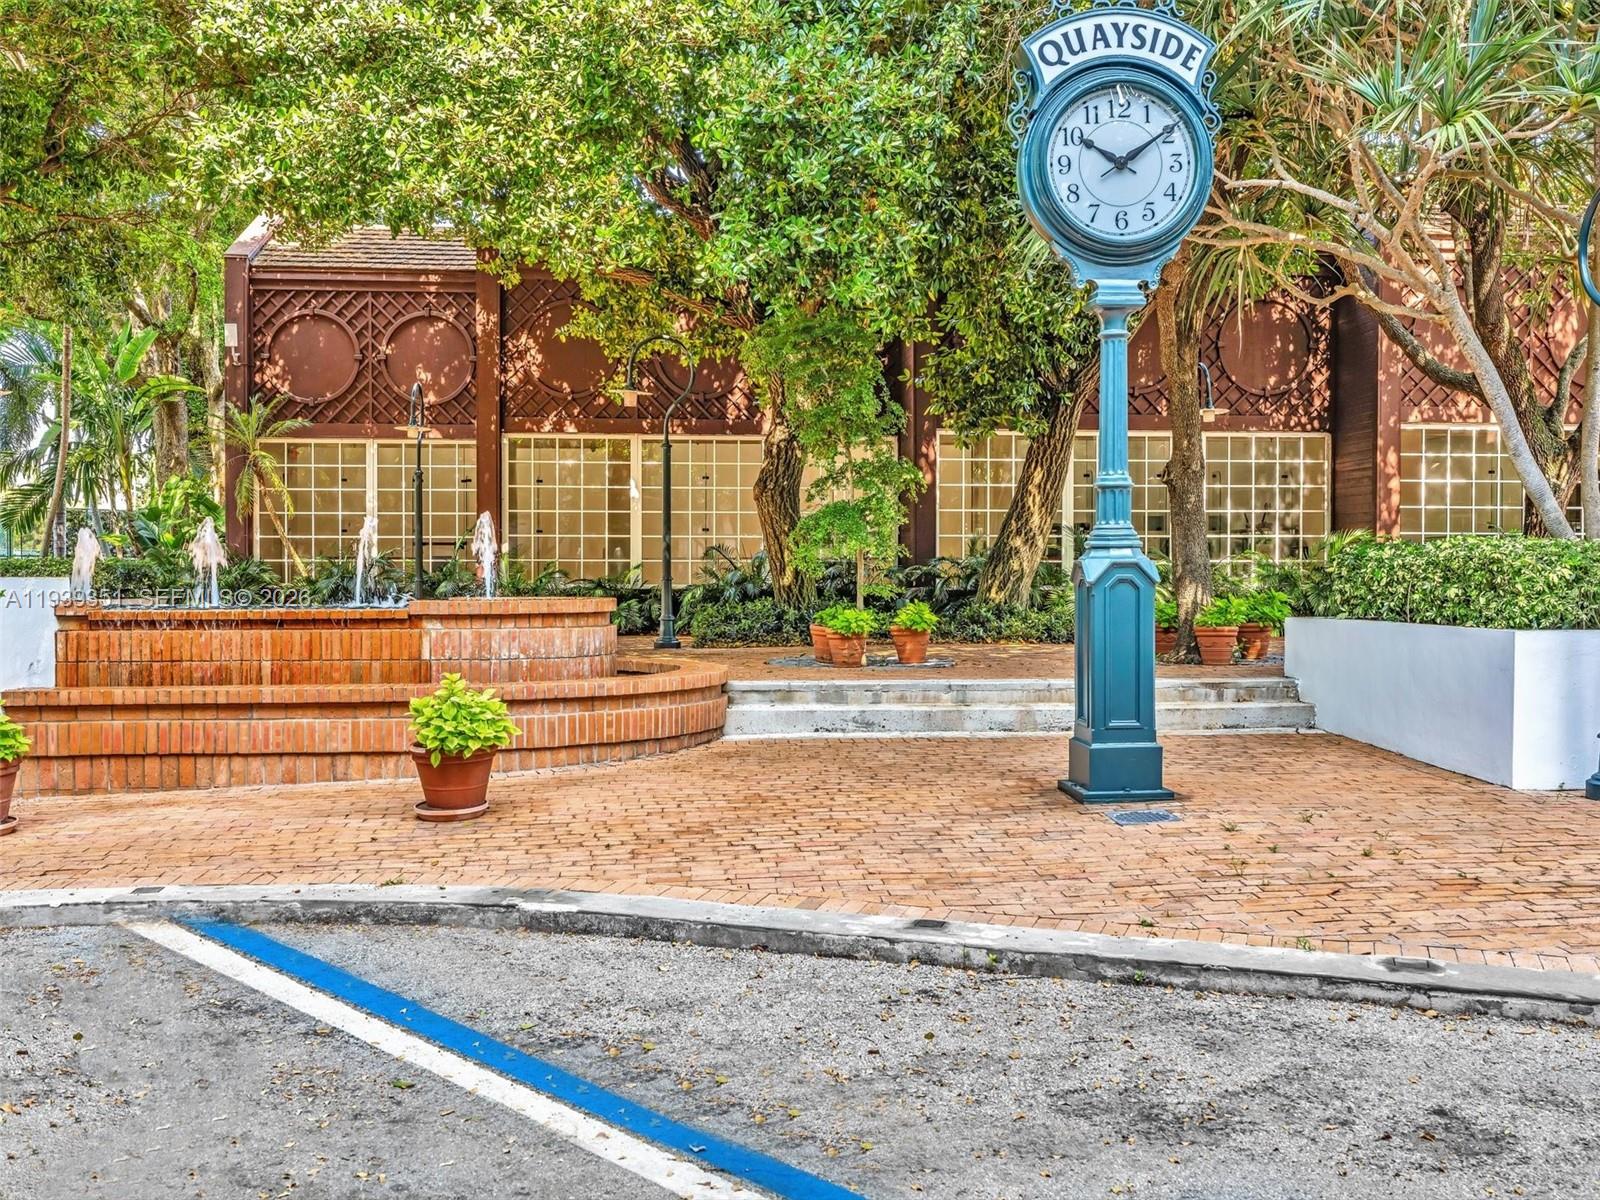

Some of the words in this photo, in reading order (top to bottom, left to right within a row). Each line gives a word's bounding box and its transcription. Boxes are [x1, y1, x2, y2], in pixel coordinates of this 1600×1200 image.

[1037, 22, 1202, 71] QUAYSIDE
[1084, 105, 1099, 124] 11
[1108, 100, 1131, 118] 12
[1144, 105, 1150, 123] 1
[1062, 127, 1083, 146] 10
[1057, 154, 1071, 175] 9
[1169, 153, 1183, 172] 3
[1066, 183, 1080, 203] 8
[1163, 182, 1177, 201] 4
[1088, 204, 1100, 223] 7
[1115, 210, 1128, 230] 6
[1142, 202, 1155, 221] 5
